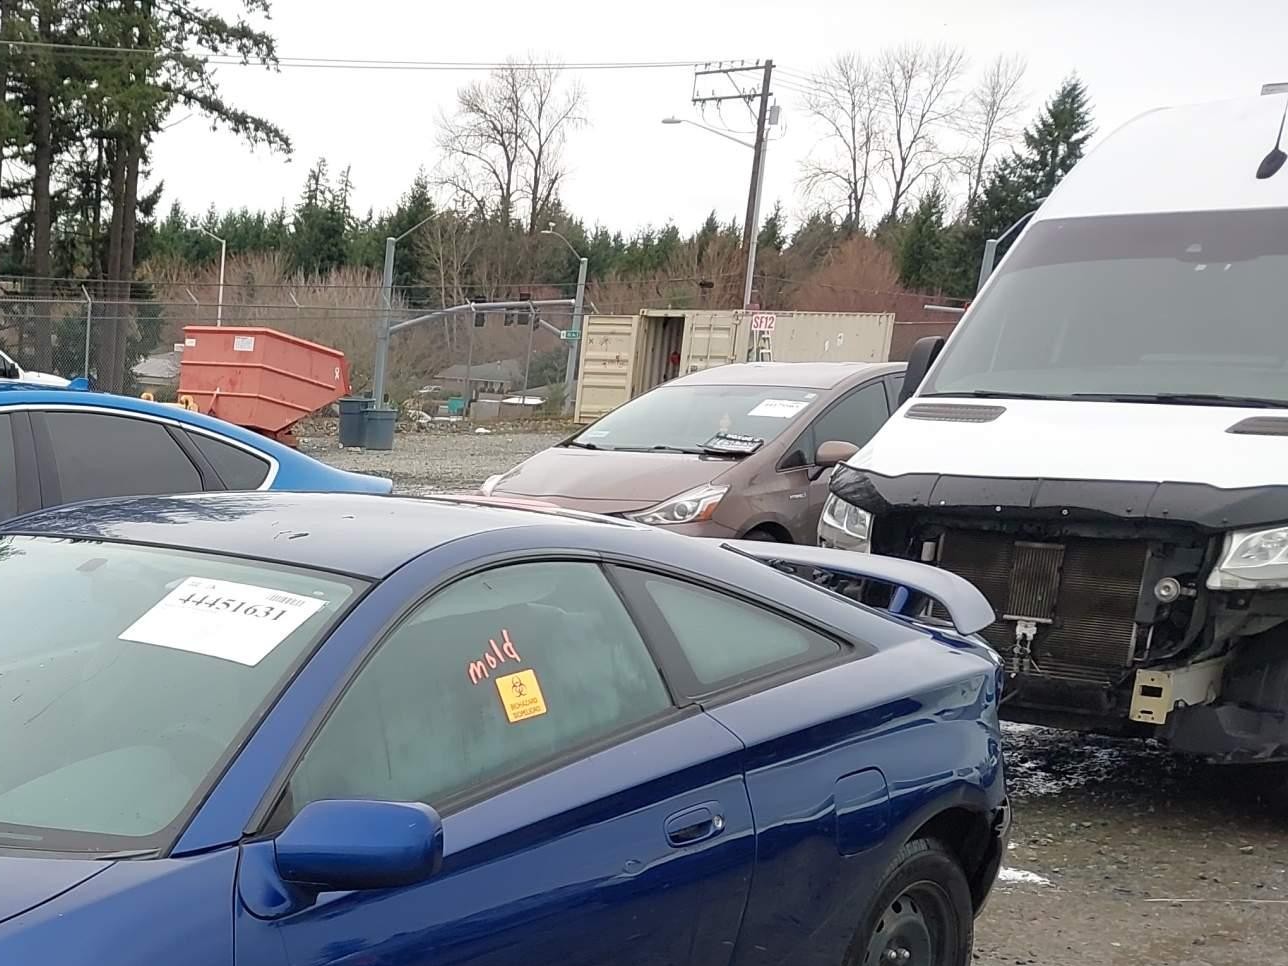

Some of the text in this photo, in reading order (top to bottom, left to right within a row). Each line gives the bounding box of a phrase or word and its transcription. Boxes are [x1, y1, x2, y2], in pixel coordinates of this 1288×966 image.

[753, 315, 775, 329] SF12
[179, 593, 286, 621] 44451631
[469, 629, 521, 684] mold
